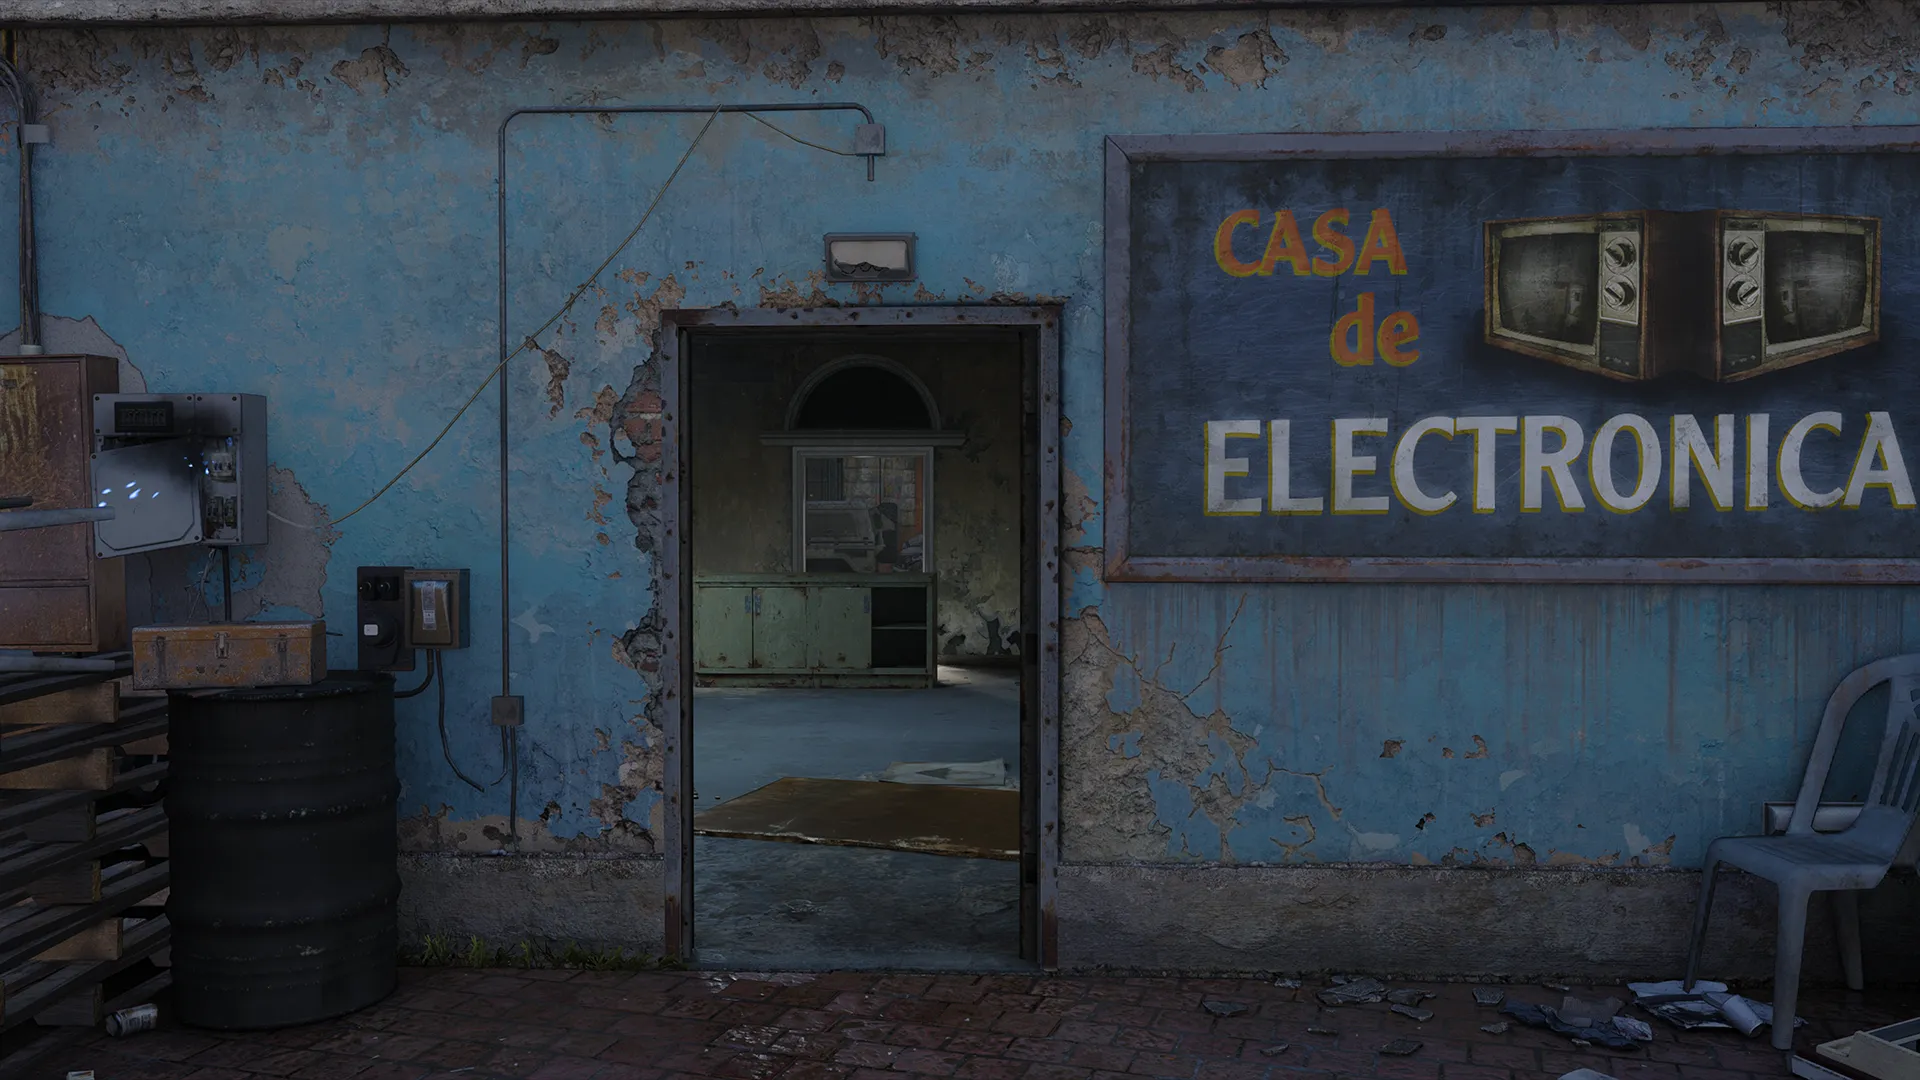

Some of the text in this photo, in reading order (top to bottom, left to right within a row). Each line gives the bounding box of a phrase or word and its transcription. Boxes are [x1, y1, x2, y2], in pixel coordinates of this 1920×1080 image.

[1214, 208, 1408, 277] CASA
[1329, 292, 1420, 367] de
[1205, 411, 1917, 516] ELECTRONICA
